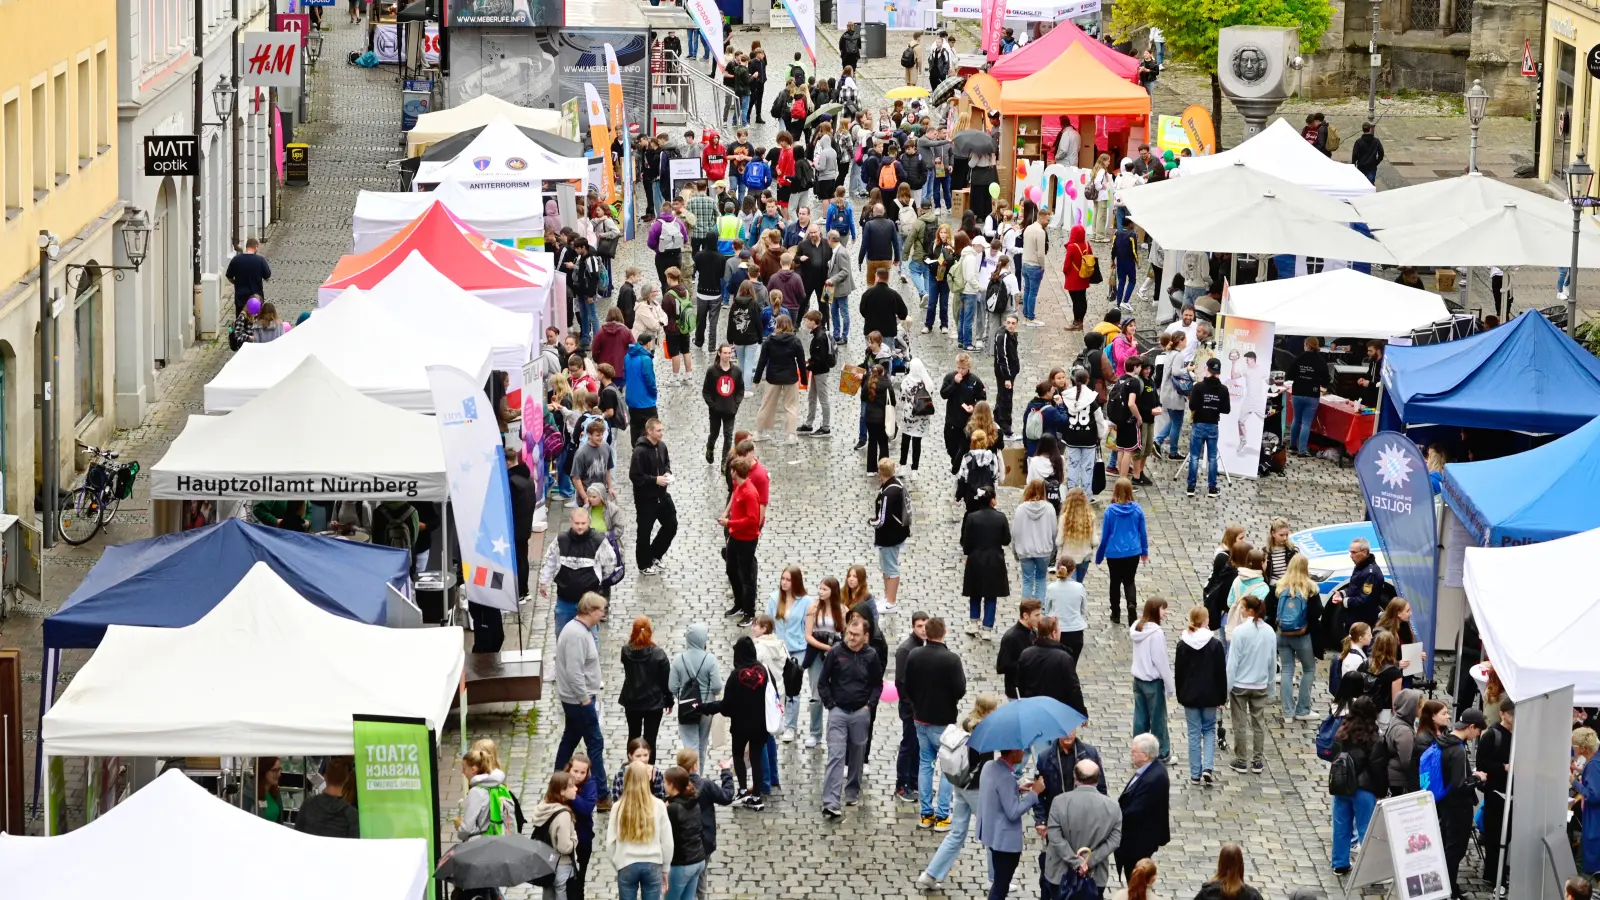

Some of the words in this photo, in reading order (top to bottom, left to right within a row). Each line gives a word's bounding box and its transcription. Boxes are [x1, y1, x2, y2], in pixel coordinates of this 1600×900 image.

[248, 43, 296, 76] H&M
[563, 65, 641, 73] WWW.MEBERE.INFO
[148, 140, 195, 157] MATT
[153, 159, 188, 173] optik
[469, 181, 530, 190] ANTITERRORISM
[177, 475, 315, 496] Hauptzollamt
[321, 476, 418, 497] Nürnberg
[1501, 535, 1542, 548] Poli
